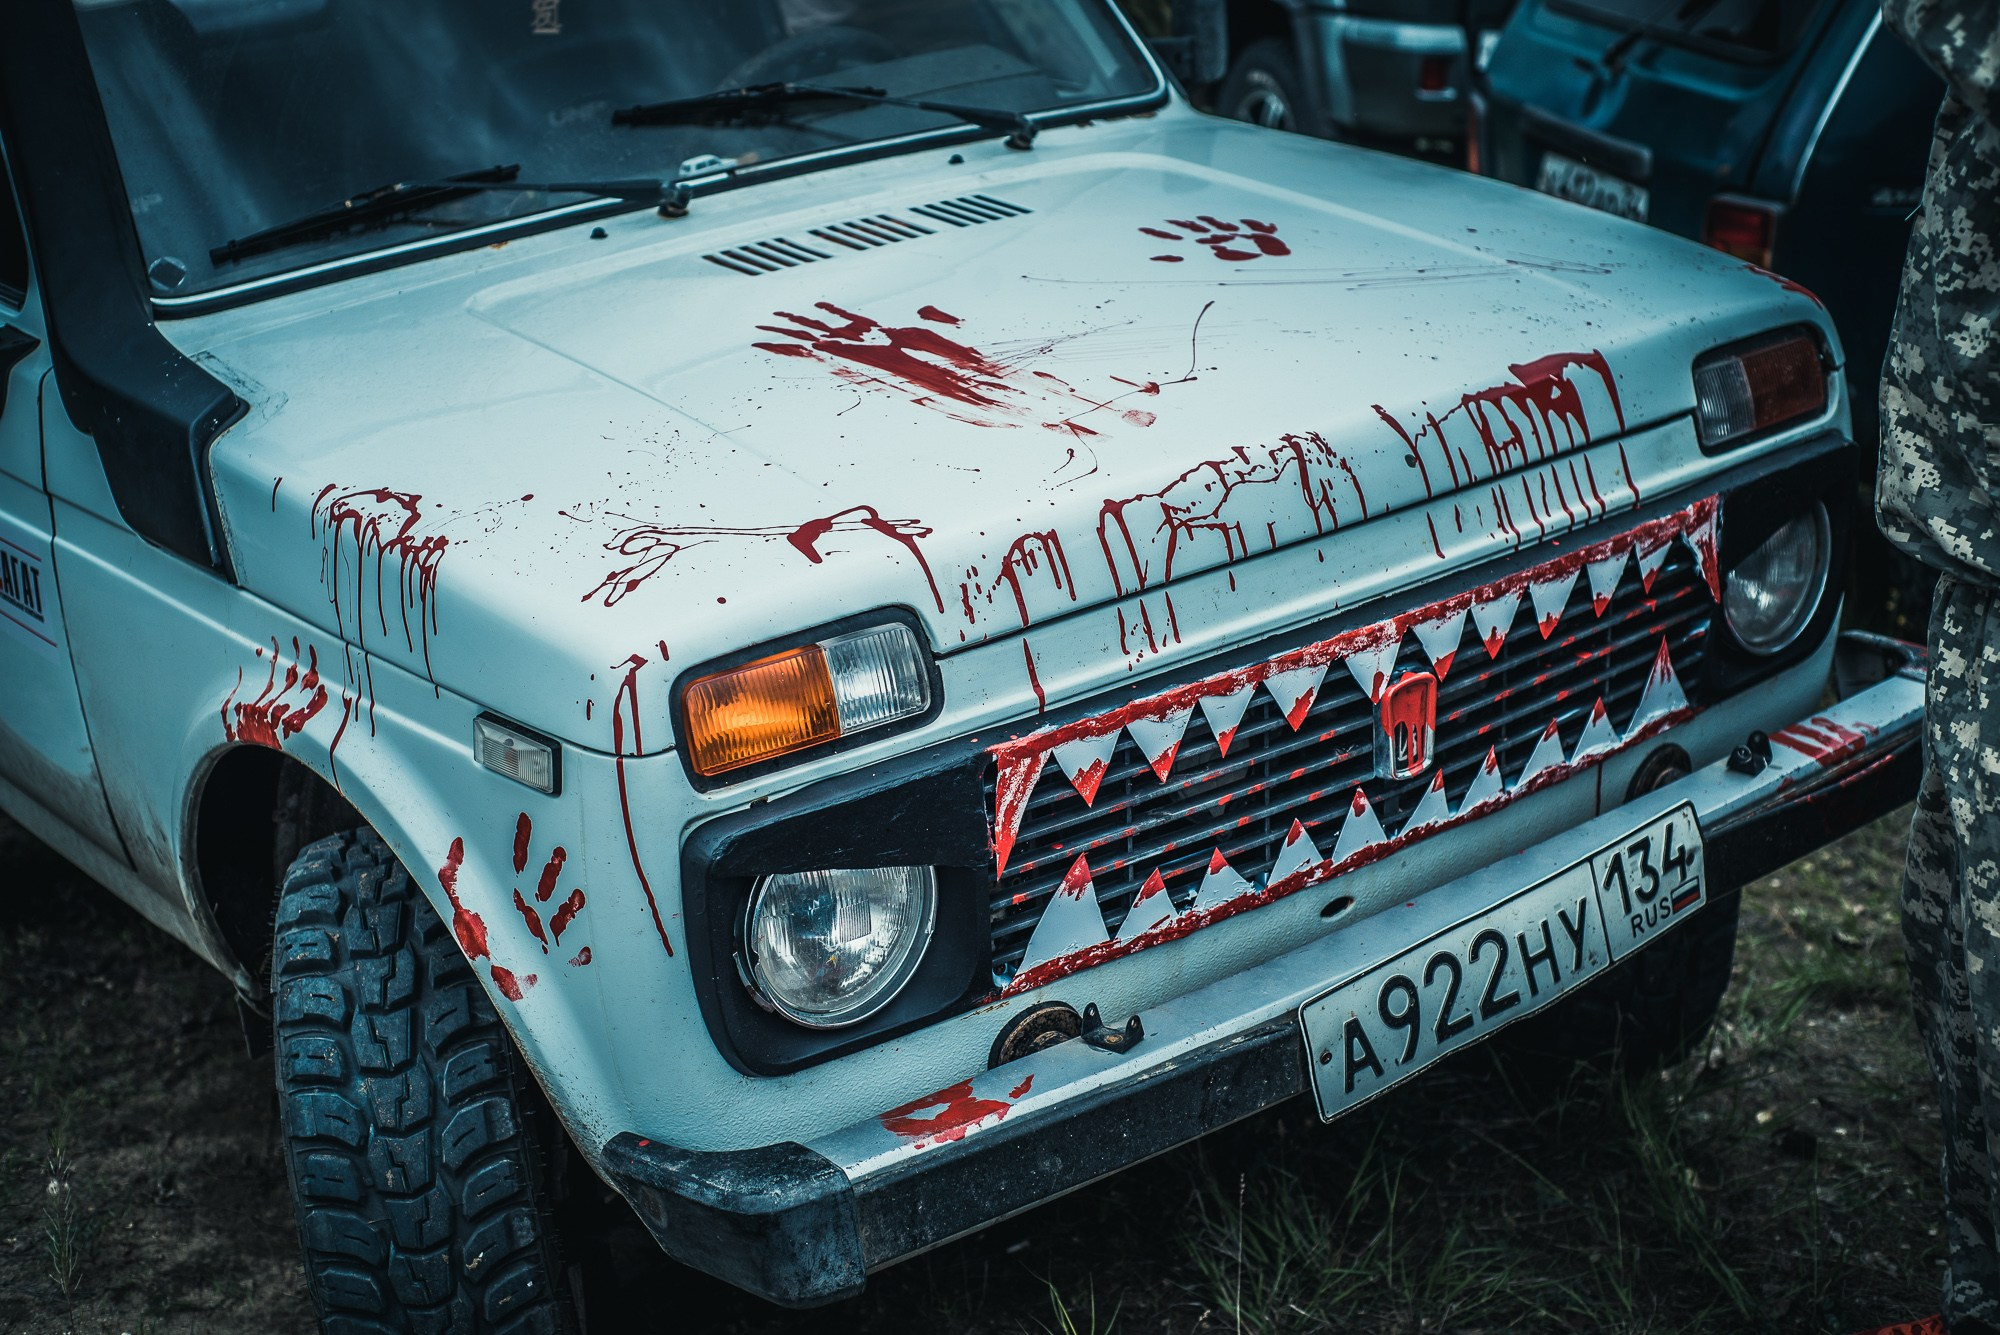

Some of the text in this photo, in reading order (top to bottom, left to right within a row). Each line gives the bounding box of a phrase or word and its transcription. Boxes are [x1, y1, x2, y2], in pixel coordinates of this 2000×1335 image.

[0, 550, 42, 613] АГАТ
[1603, 822, 1687, 916] 134
[1631, 898, 1671, 938] RUS
